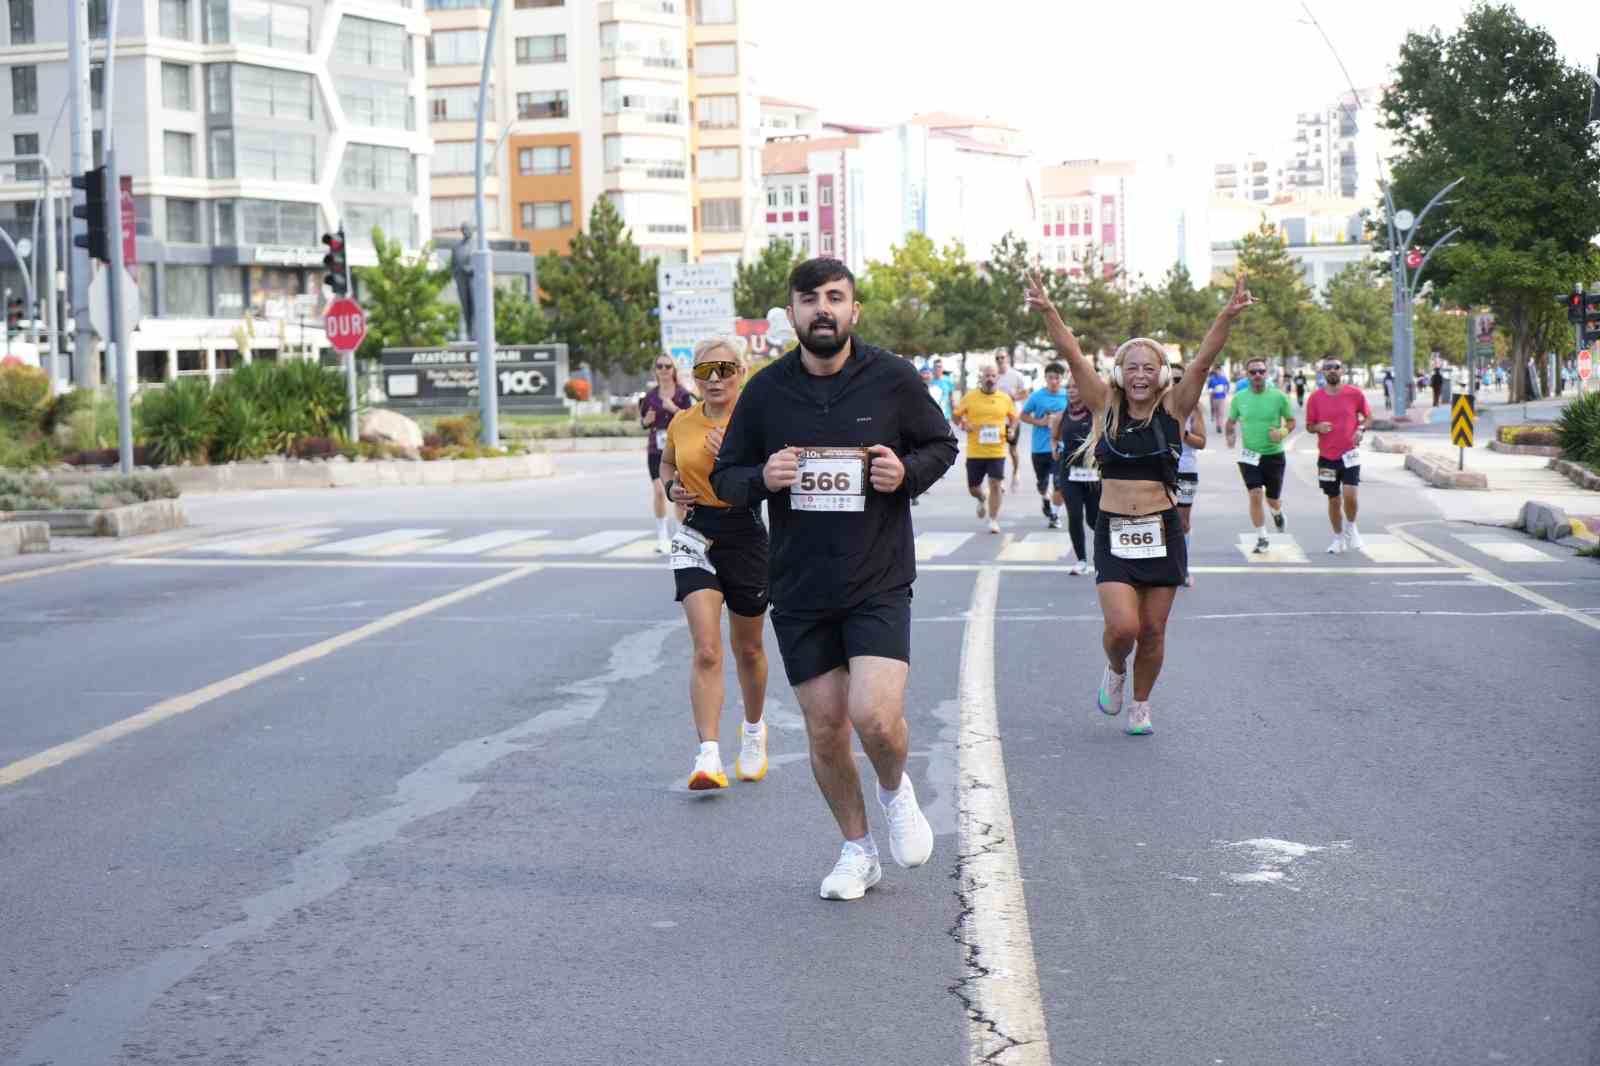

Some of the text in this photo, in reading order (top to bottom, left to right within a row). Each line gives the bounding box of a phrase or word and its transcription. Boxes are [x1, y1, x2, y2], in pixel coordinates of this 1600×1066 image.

[327, 313, 361, 337] DUR
[411, 350, 466, 363] ATATÜRK
[800, 471, 850, 491] 566
[1119, 532, 1154, 545] 666
